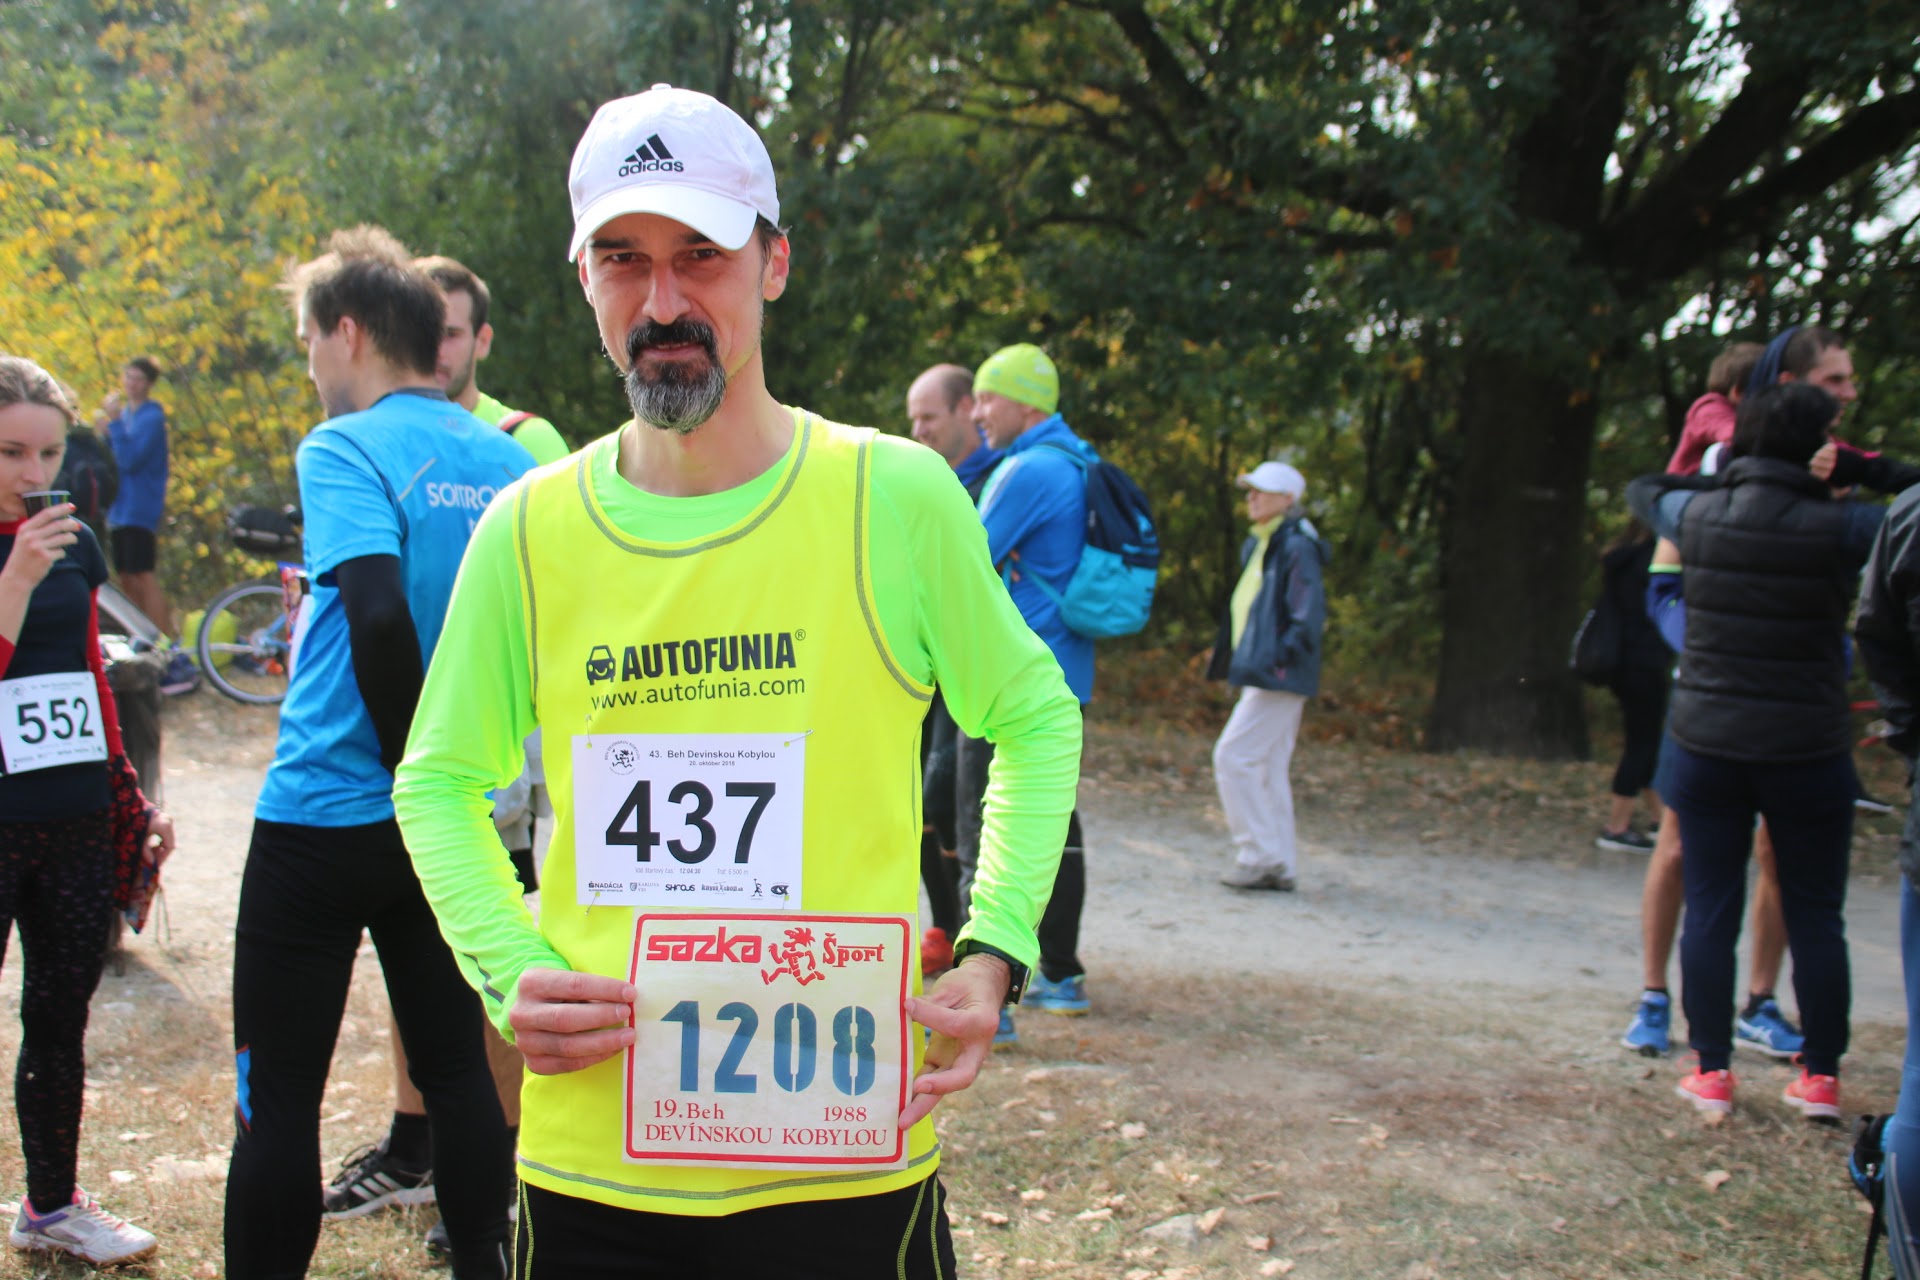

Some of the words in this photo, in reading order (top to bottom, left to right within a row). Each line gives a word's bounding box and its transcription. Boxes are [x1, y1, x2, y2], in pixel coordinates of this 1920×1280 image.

[618, 158, 684, 177] adidas
[426, 482, 500, 511] SOITRO
[591, 677, 806, 711] www.autofunia.com
[17, 696, 94, 744] 552
[649, 750, 662, 758] 43.
[667, 750, 685, 758] Beh
[738, 750, 776, 760] Kobylou
[605, 780, 776, 864] 437
[822, 932, 885, 968] Šport
[660, 1000, 876, 1096] 1208
[823, 1106, 867, 1122] 1988
[645, 1122, 772, 1145] DEVÍNSKOU
[782, 1128, 888, 1146] KOBYLOU
